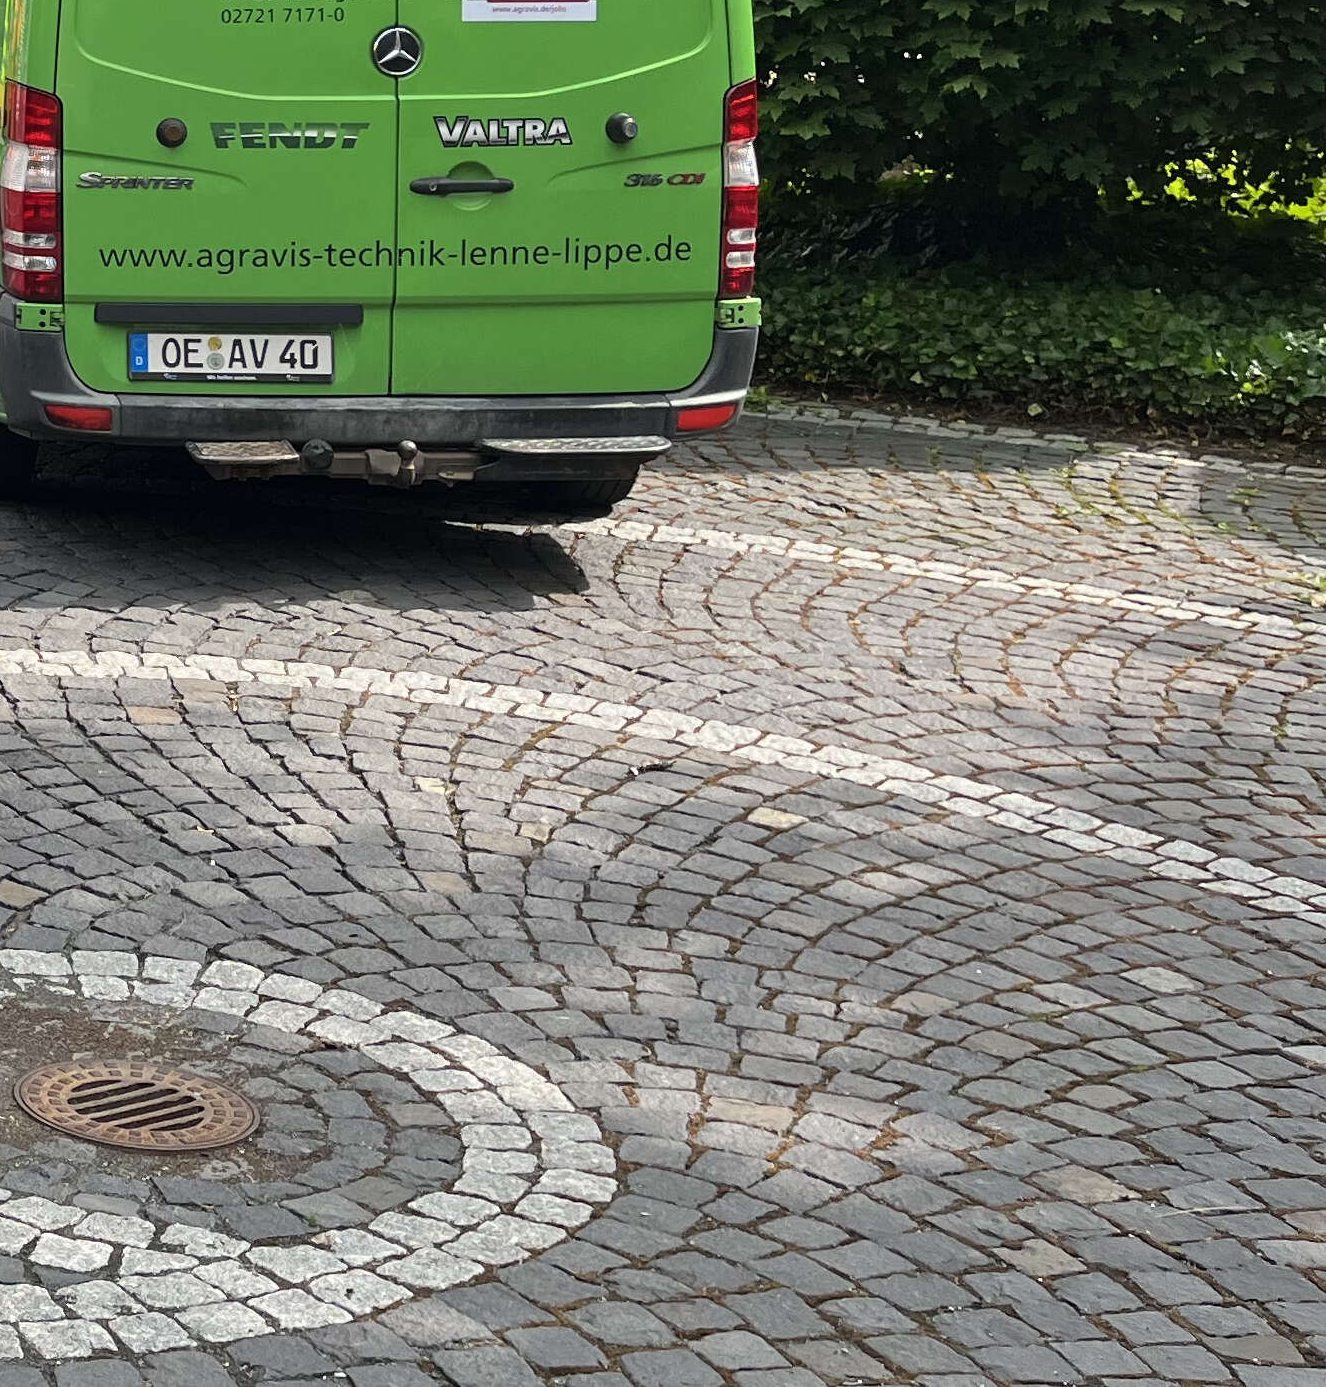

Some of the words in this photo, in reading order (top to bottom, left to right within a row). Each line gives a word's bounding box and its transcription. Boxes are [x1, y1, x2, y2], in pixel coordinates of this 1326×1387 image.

[221, 8, 274, 24] 02721
[283, 7, 345, 23] 7171-0
[209, 122, 371, 149] FENDT
[432, 115, 574, 148] VALTRA
[624, 172, 663, 188] 316
[666, 172, 705, 187] CDI
[99, 234, 693, 275] www.agravis-technik-lenne-lippe.de
[135, 356, 144, 367] D
[161, 337, 204, 368] OE
[228, 338, 269, 369] AV
[279, 339, 319, 370] 40
